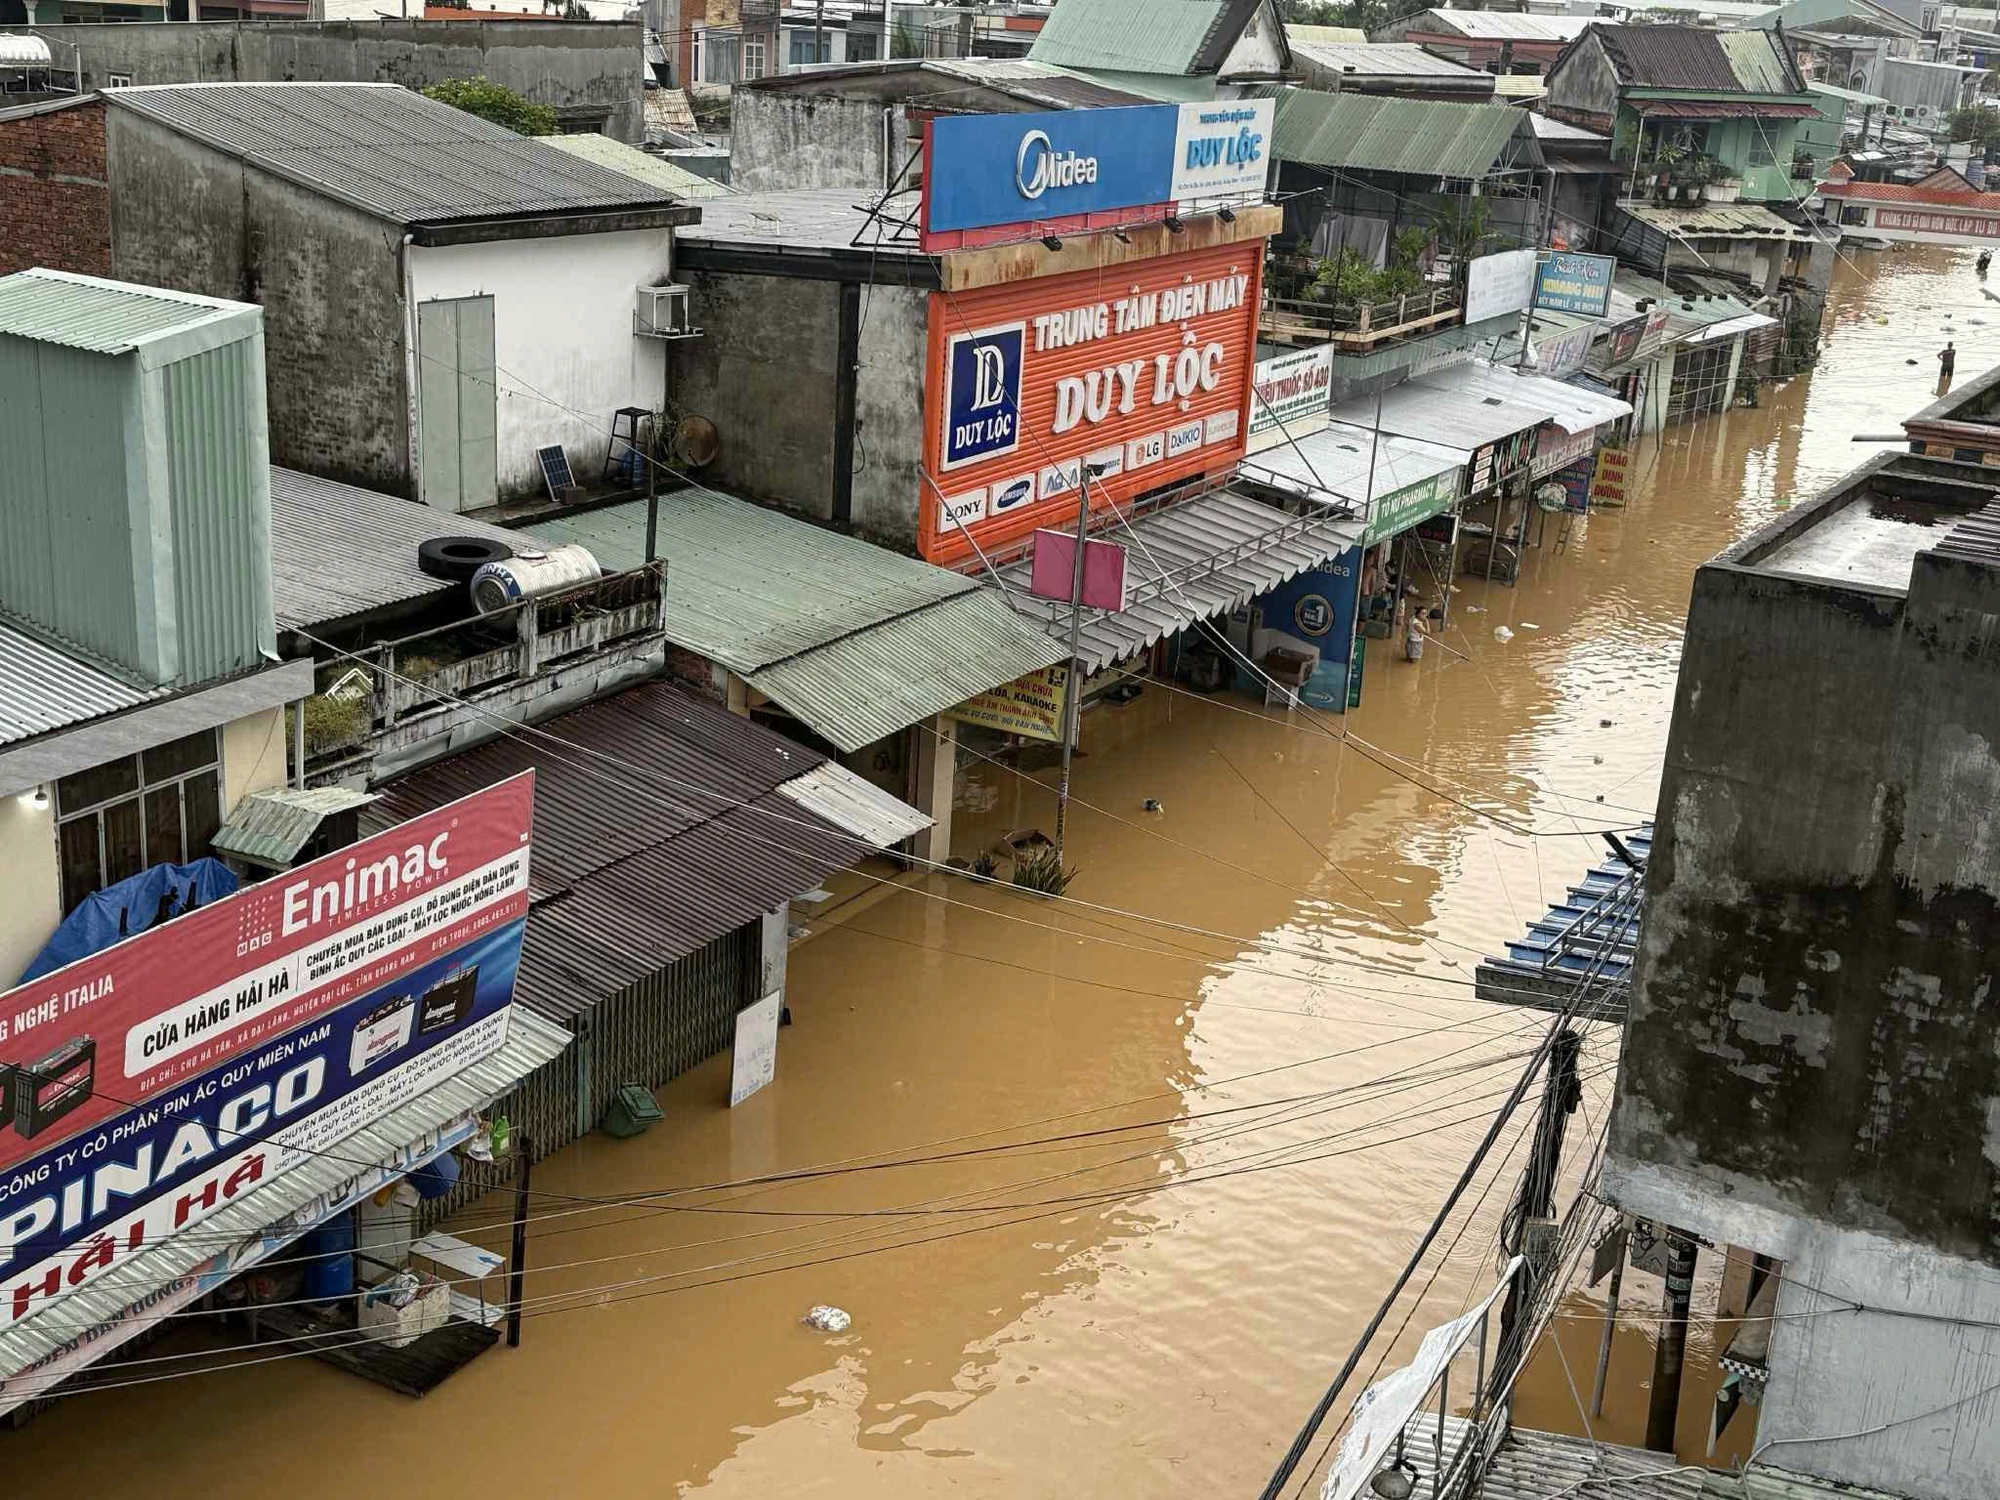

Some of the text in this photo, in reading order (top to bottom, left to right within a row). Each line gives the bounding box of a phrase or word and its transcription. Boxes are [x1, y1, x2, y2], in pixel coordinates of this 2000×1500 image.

[1020, 140, 1098, 193] Midea
[1186, 126, 1263, 171] DUY LỘC
[1032, 265, 1249, 352] TRUNG TÂM ĐIỆN MÁY
[1052, 330, 1224, 435] DUY LỘC
[955, 410, 1012, 450] DUY LỘC
[1146, 441, 1160, 458] LG
[1170, 427, 1200, 449] DAIKIO
[945, 499, 982, 521] SONY
[1013, 692, 1058, 713] KARAOKE
[281, 831, 449, 938] Enimac
[306, 942, 342, 967] CHUYÊN
[344, 931, 365, 950] MUA
[367, 923, 384, 939] BÁN
[386, 913, 409, 934] DỤNG
[440, 884, 462, 907] DÙNG
[463, 875, 481, 898] ĐIỆN
[482, 868, 498, 885] DÂN
[499, 859, 519, 880] DỤNG
[328, 867, 450, 928] TIMELESS POWER
[237, 931, 272, 957] MAC
[310, 957, 332, 981] BÌNH
[333, 951, 346, 970] ẮC
[347, 945, 366, 965] QUY
[367, 937, 386, 959] CÁC
[387, 929, 407, 951] LOẠI
[414, 917, 431, 934] MÁY
[433, 908, 449, 927] LỌC
[474, 888, 495, 907] NÓNG
[496, 876, 515, 898] LẠNH
[14, 993, 59, 1035] NGHỆ
[64, 974, 114, 1013] ITALIA
[143, 967, 290, 1058] CỬA HÀNG HẢI HÀ
[0, 1023, 332, 1201] CÔNG TY CỔ PHẦN PIN ẮC QUY MIỀN NAM
[321, 1118, 341, 1136] QUY
[341, 1105, 361, 1122] CÁC
[361, 1093, 383, 1110] LOẠI
[389, 1080, 407, 1095] MÁY
[452, 1040, 477, 1059] NÓNG
[279, 1116, 316, 1143] CHUYÊN
[318, 1106, 338, 1122] MUA
[340, 1096, 359, 1110] BÁN
[0, 1056, 327, 1267] PINACO
[12, 1219, 146, 1321] HẢI
[174, 1152, 266, 1229] HÀ
